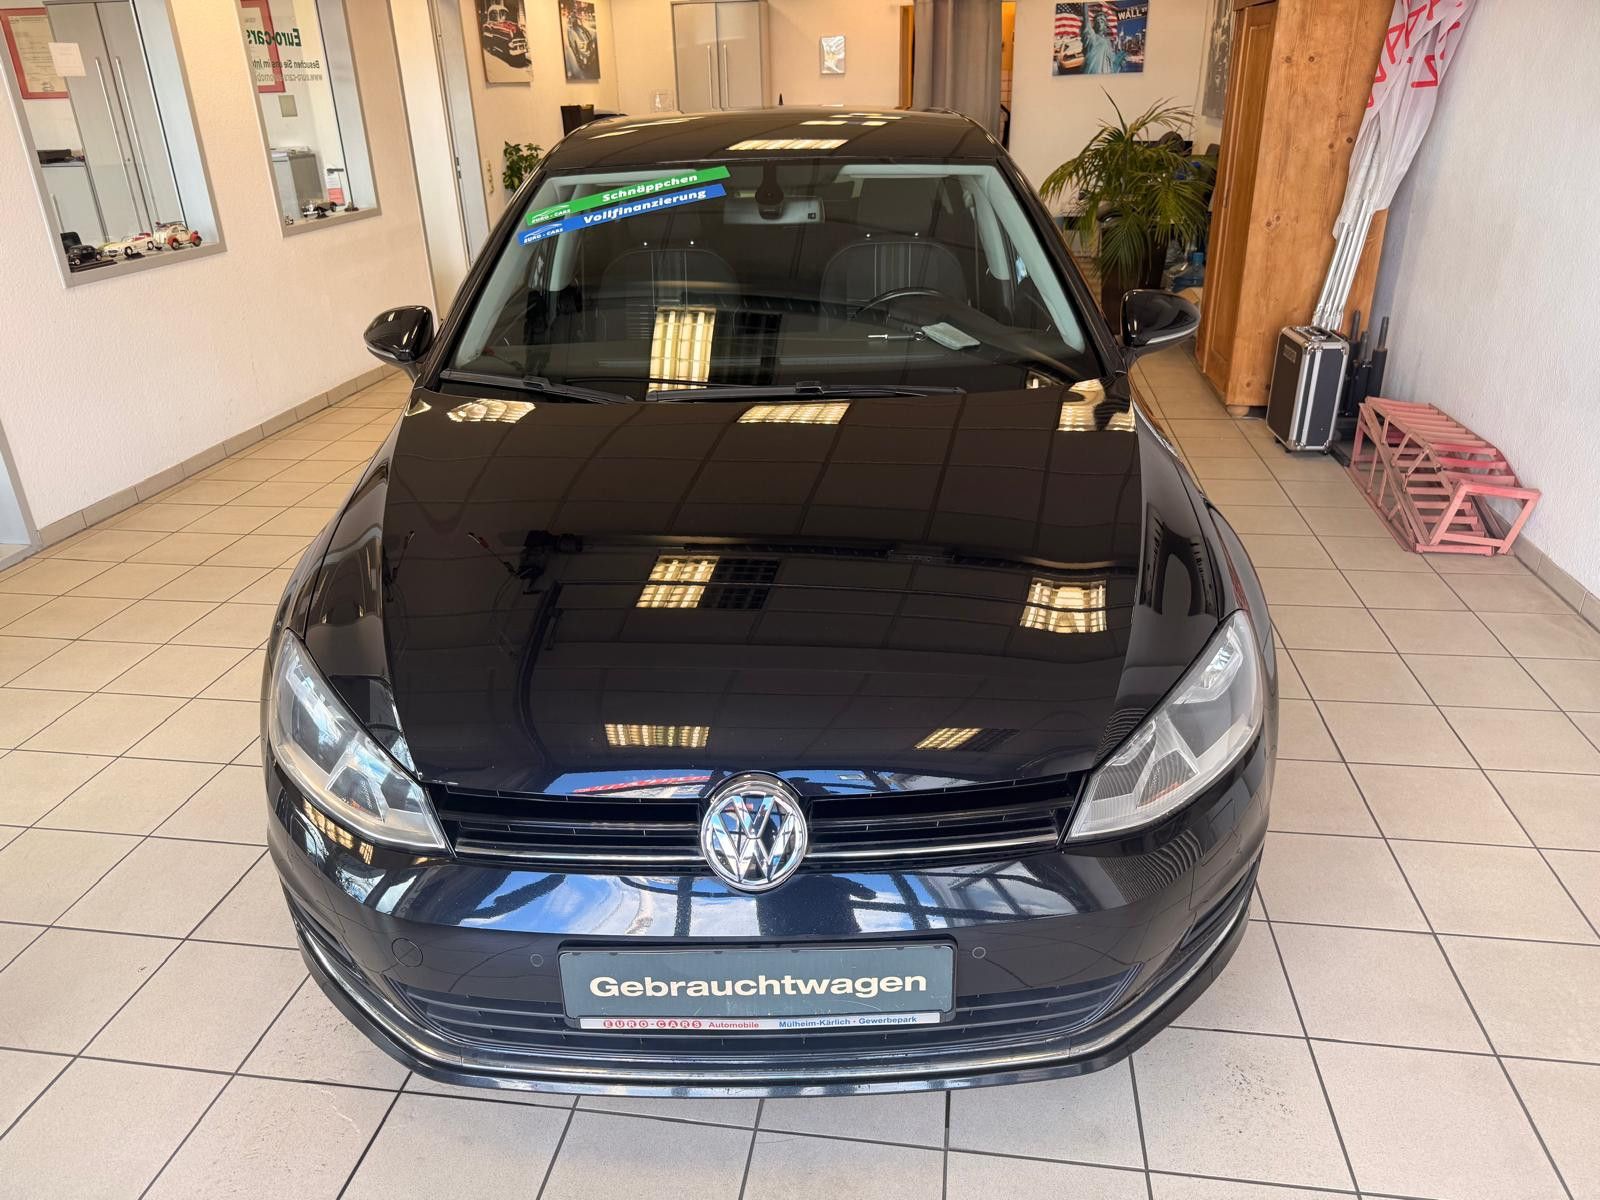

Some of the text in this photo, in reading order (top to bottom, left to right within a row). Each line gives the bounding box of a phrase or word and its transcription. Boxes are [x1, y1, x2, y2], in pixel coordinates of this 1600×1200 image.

[1118, 9, 1142, 20] WALL
[602, 175, 698, 202] Schnäppchen
[583, 189, 707, 225] Vollfinanzierung
[554, 209, 571, 218] CARS
[546, 228, 564, 236] CARS
[589, 974, 928, 998] Gebrauchtwagen
[708, 1021, 760, 1029] Automobile
[778, 1018, 851, 1028] Mülheim-Kärlich
[858, 1016, 917, 1025] Gewerbepark
